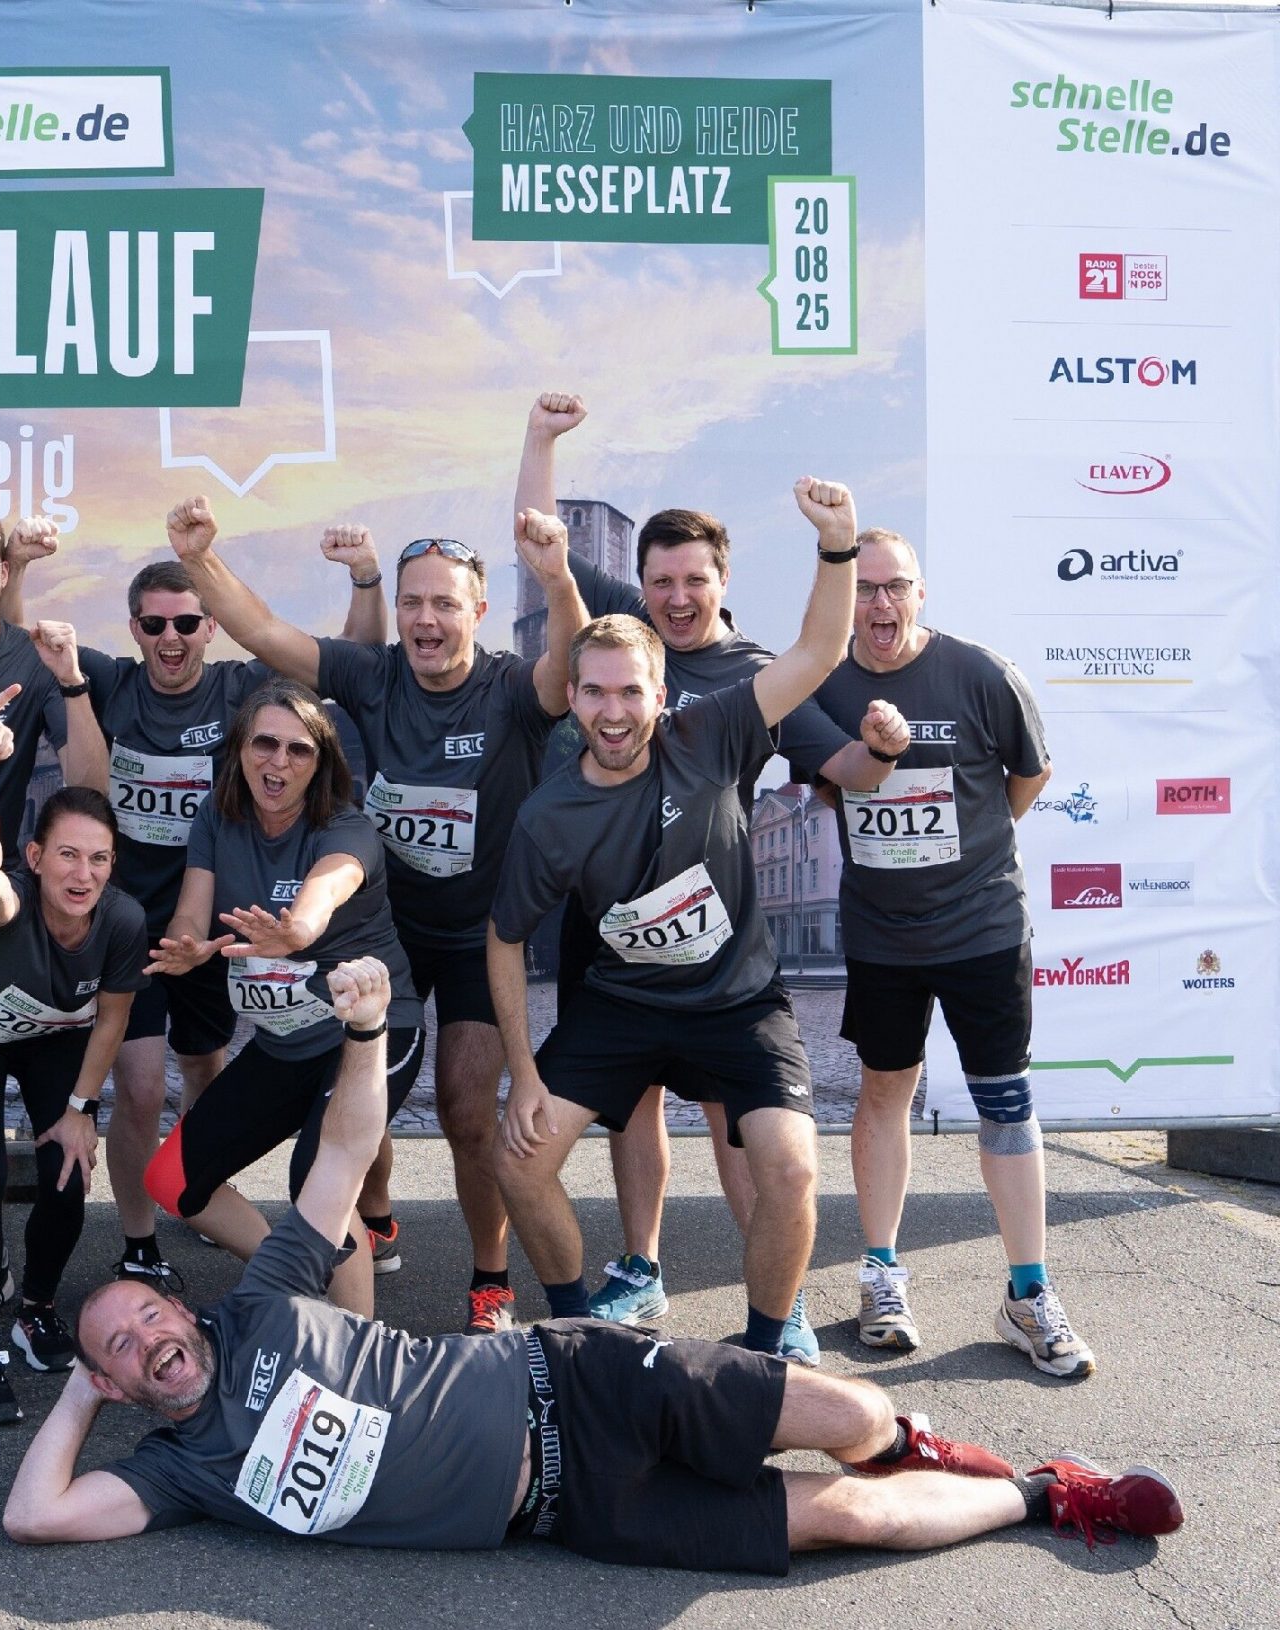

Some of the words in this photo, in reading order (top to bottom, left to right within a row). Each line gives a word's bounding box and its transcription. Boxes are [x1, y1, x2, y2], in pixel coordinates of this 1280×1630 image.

[1010, 74, 1173, 114] schnelle
[501, 103, 596, 153] HARZ
[609, 105, 682, 155] UND
[696, 106, 799, 156] HEIDE
[1056, 118, 1231, 156] Stelle.de
[501, 164, 732, 214] MESSEPLATZ
[795, 197, 828, 235] 20
[795, 245, 828, 283] 08
[1085, 260, 1117, 269] RADIO
[1085, 269, 1117, 293] 21
[1130, 270, 1162, 279] ROCK
[1141, 280, 1162, 289] POP
[796, 293, 829, 331] 25
[1048, 356, 1197, 387] ALSTOM
[1089, 465, 1153, 480] CLAVEY
[1045, 648, 1191, 661] BRAUNSCHWEIGER
[1084, 662, 1154, 675] ZEITUNG
[118, 783, 199, 819] 2016
[375, 812, 459, 850] 2021
[856, 805, 944, 837] 2012
[1063, 886, 1120, 905] Linde
[618, 903, 707, 949] 2017
[235, 982, 305, 1010] 2022
[1182, 978, 1235, 989] WOLTERS
[281, 1410, 346, 1519] 2019
[541, 1425, 562, 1489] PUMA
[340, 1460, 362, 1502] schnelle
